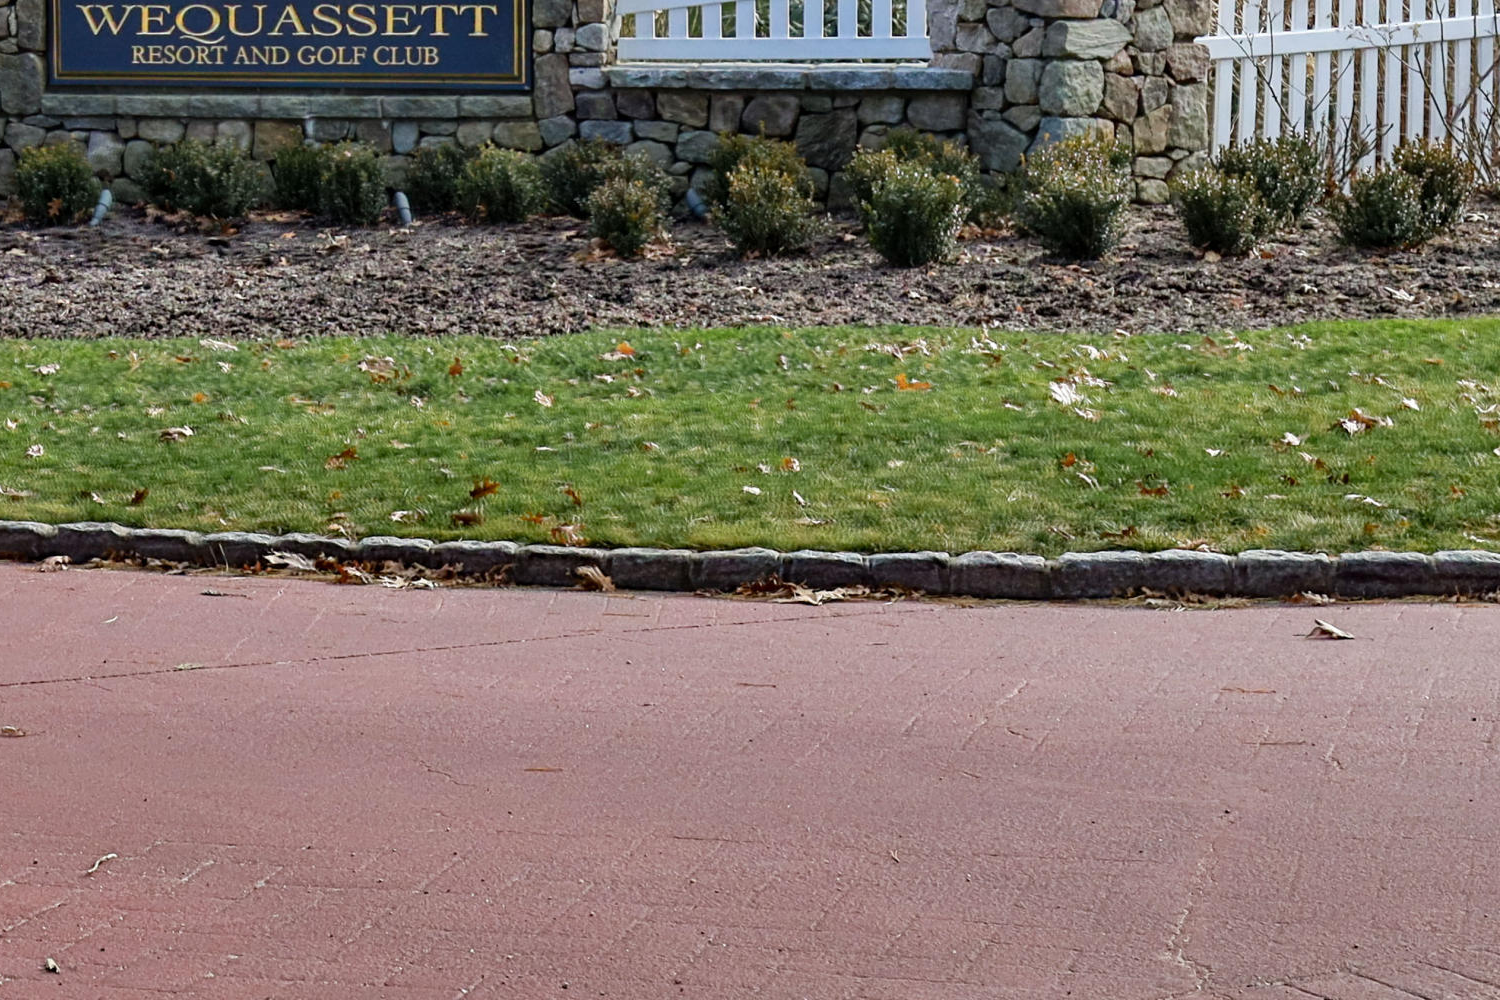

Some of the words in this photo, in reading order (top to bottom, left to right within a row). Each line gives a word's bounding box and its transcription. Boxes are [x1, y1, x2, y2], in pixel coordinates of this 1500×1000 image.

[76, 3, 498, 44] WEQUASSETT
[130, 44, 228, 65] RESORT
[234, 45, 290, 65] AND
[297, 44, 368, 65] GOLF
[373, 44, 440, 65] CLUB
